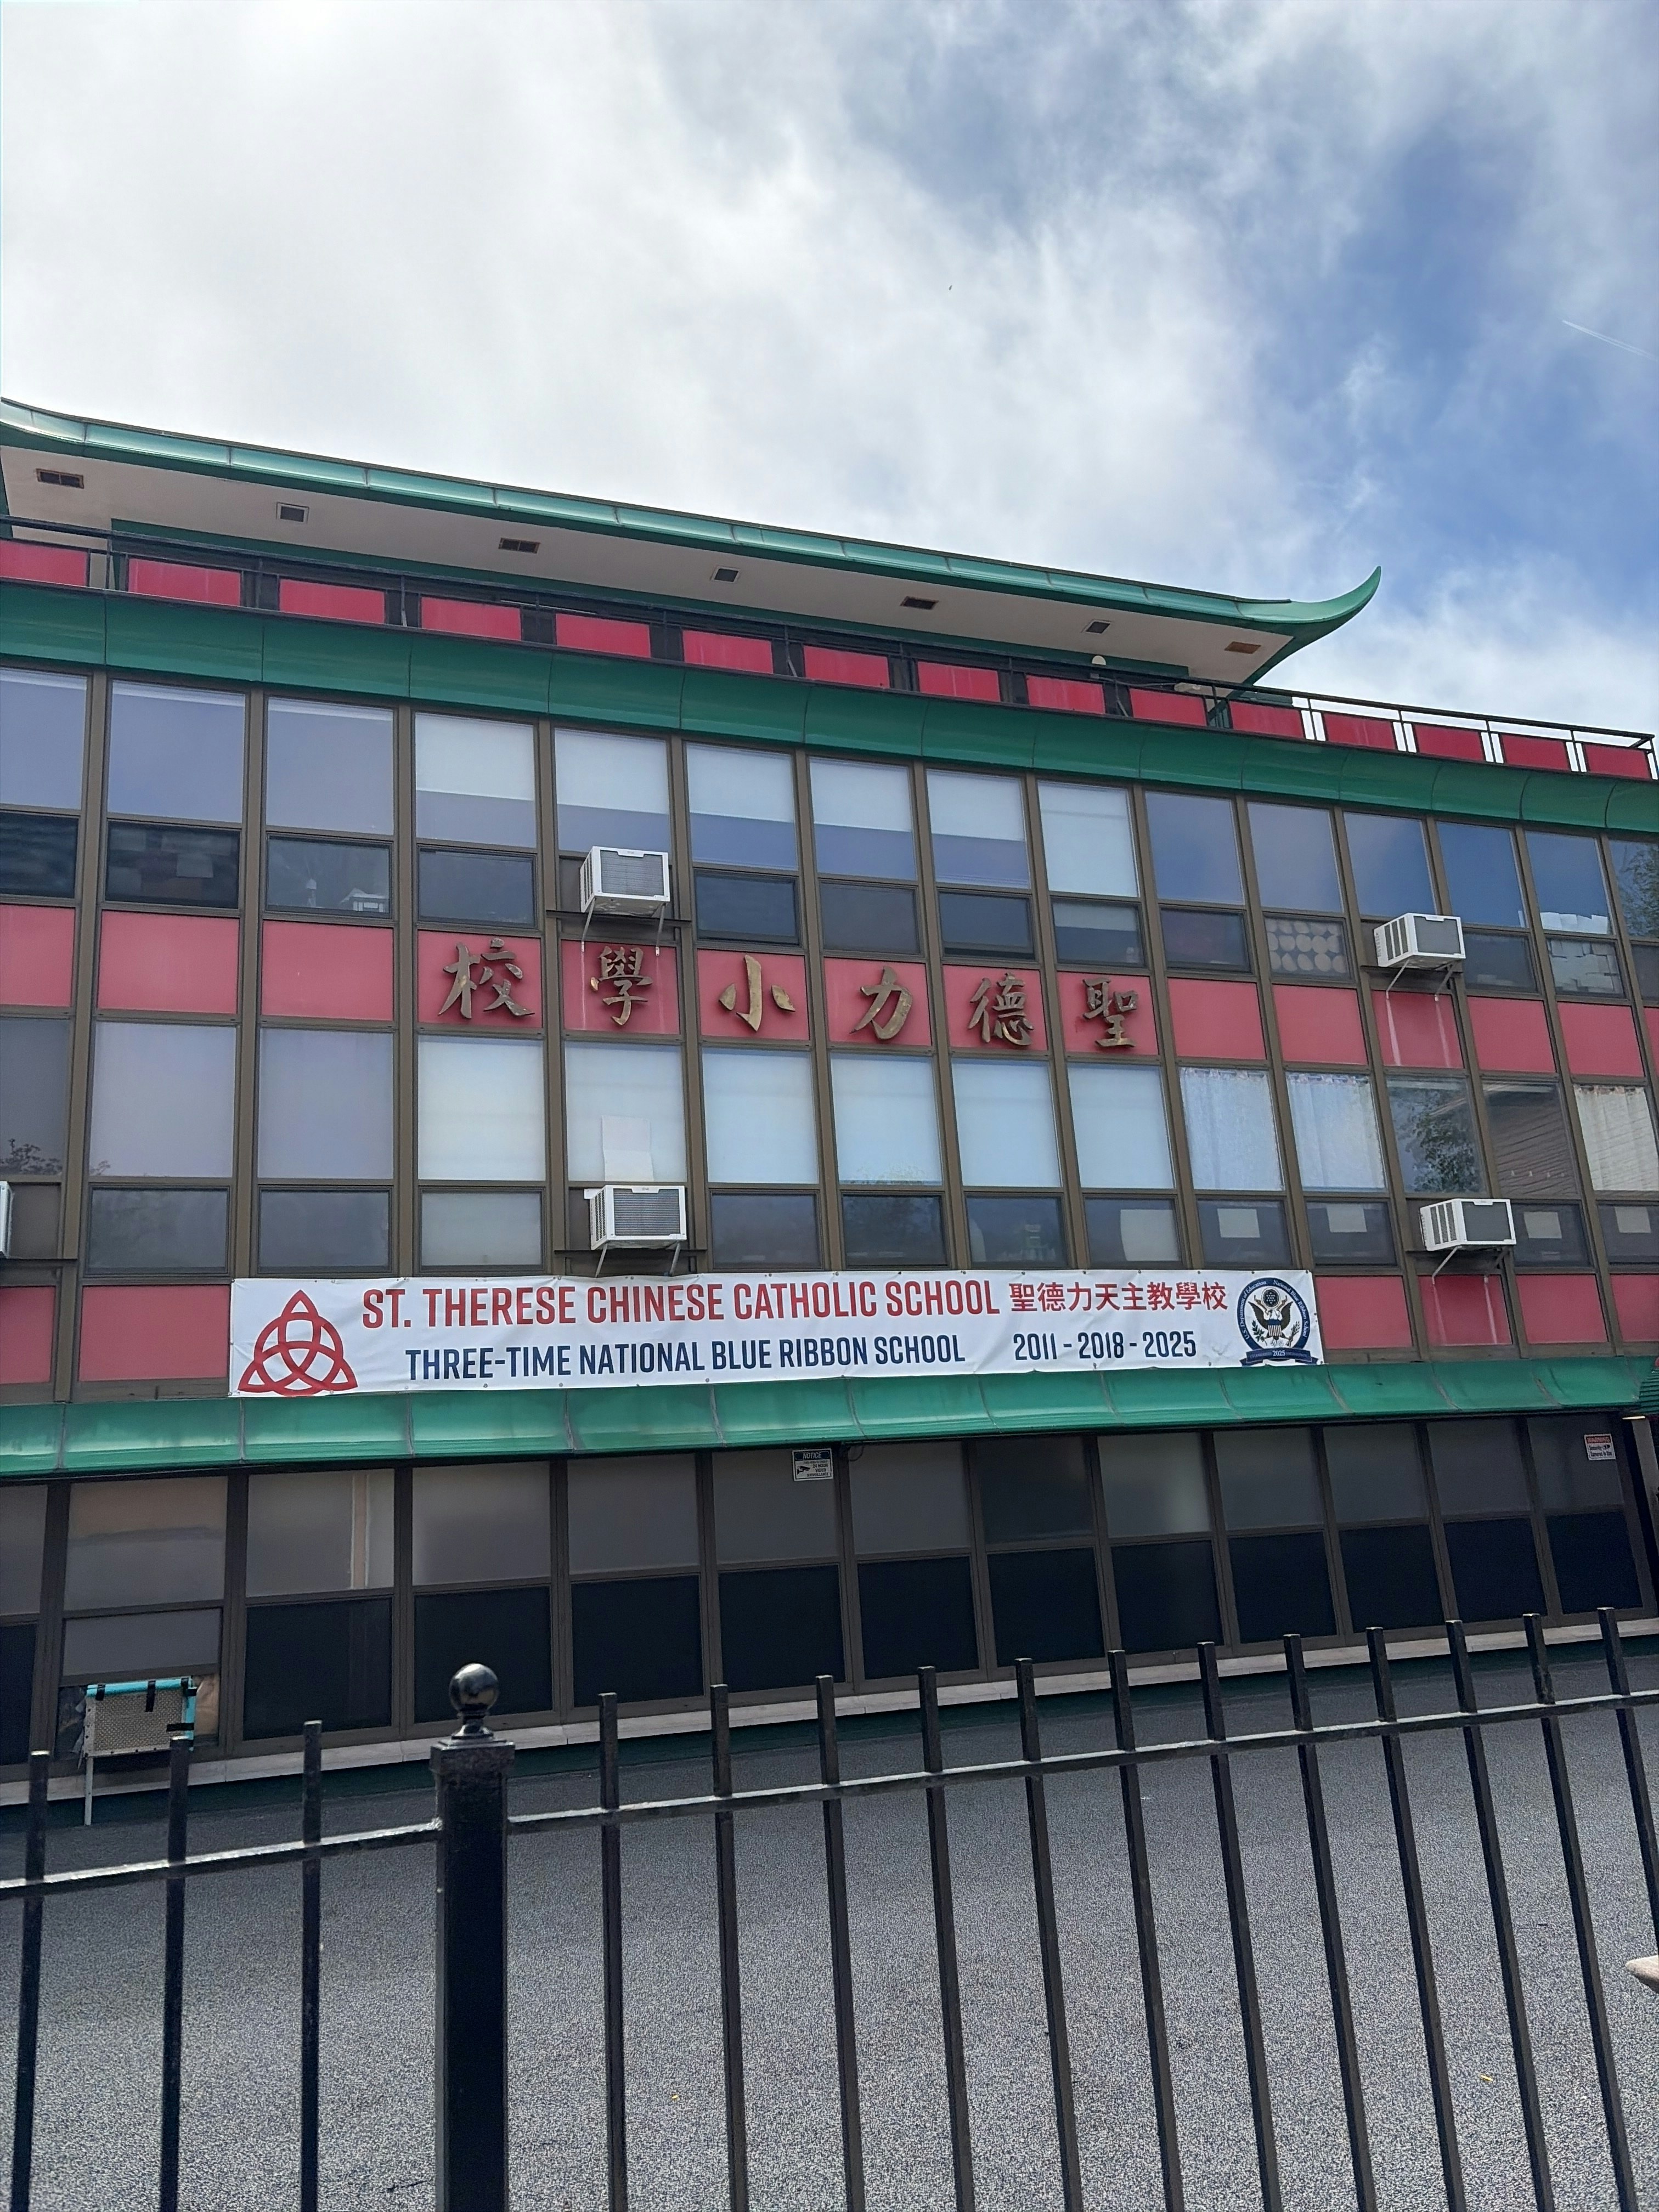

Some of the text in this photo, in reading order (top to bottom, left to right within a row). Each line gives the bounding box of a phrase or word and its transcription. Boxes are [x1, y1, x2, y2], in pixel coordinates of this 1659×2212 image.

[363, 1280, 1000, 1328] ST. THERESE CHINESE CATHOLIC SCHOOL
[1008, 1282, 1228, 1312] 聖德力天主教學校
[1246, 1280, 1267, 1293] Education
[1273, 1279, 1291, 1293] National
[1290, 1290, 1299, 1302] Blue
[1298, 1301, 1307, 1320] Ribbon
[405, 1334, 966, 1380] THREE-TIME NATIONAL BLUE RIBBON SCHOOL
[1013, 1333, 1057, 1361] 2011
[1077, 1331, 1124, 1359] 2018
[1142, 1330, 1197, 1358] 2025
